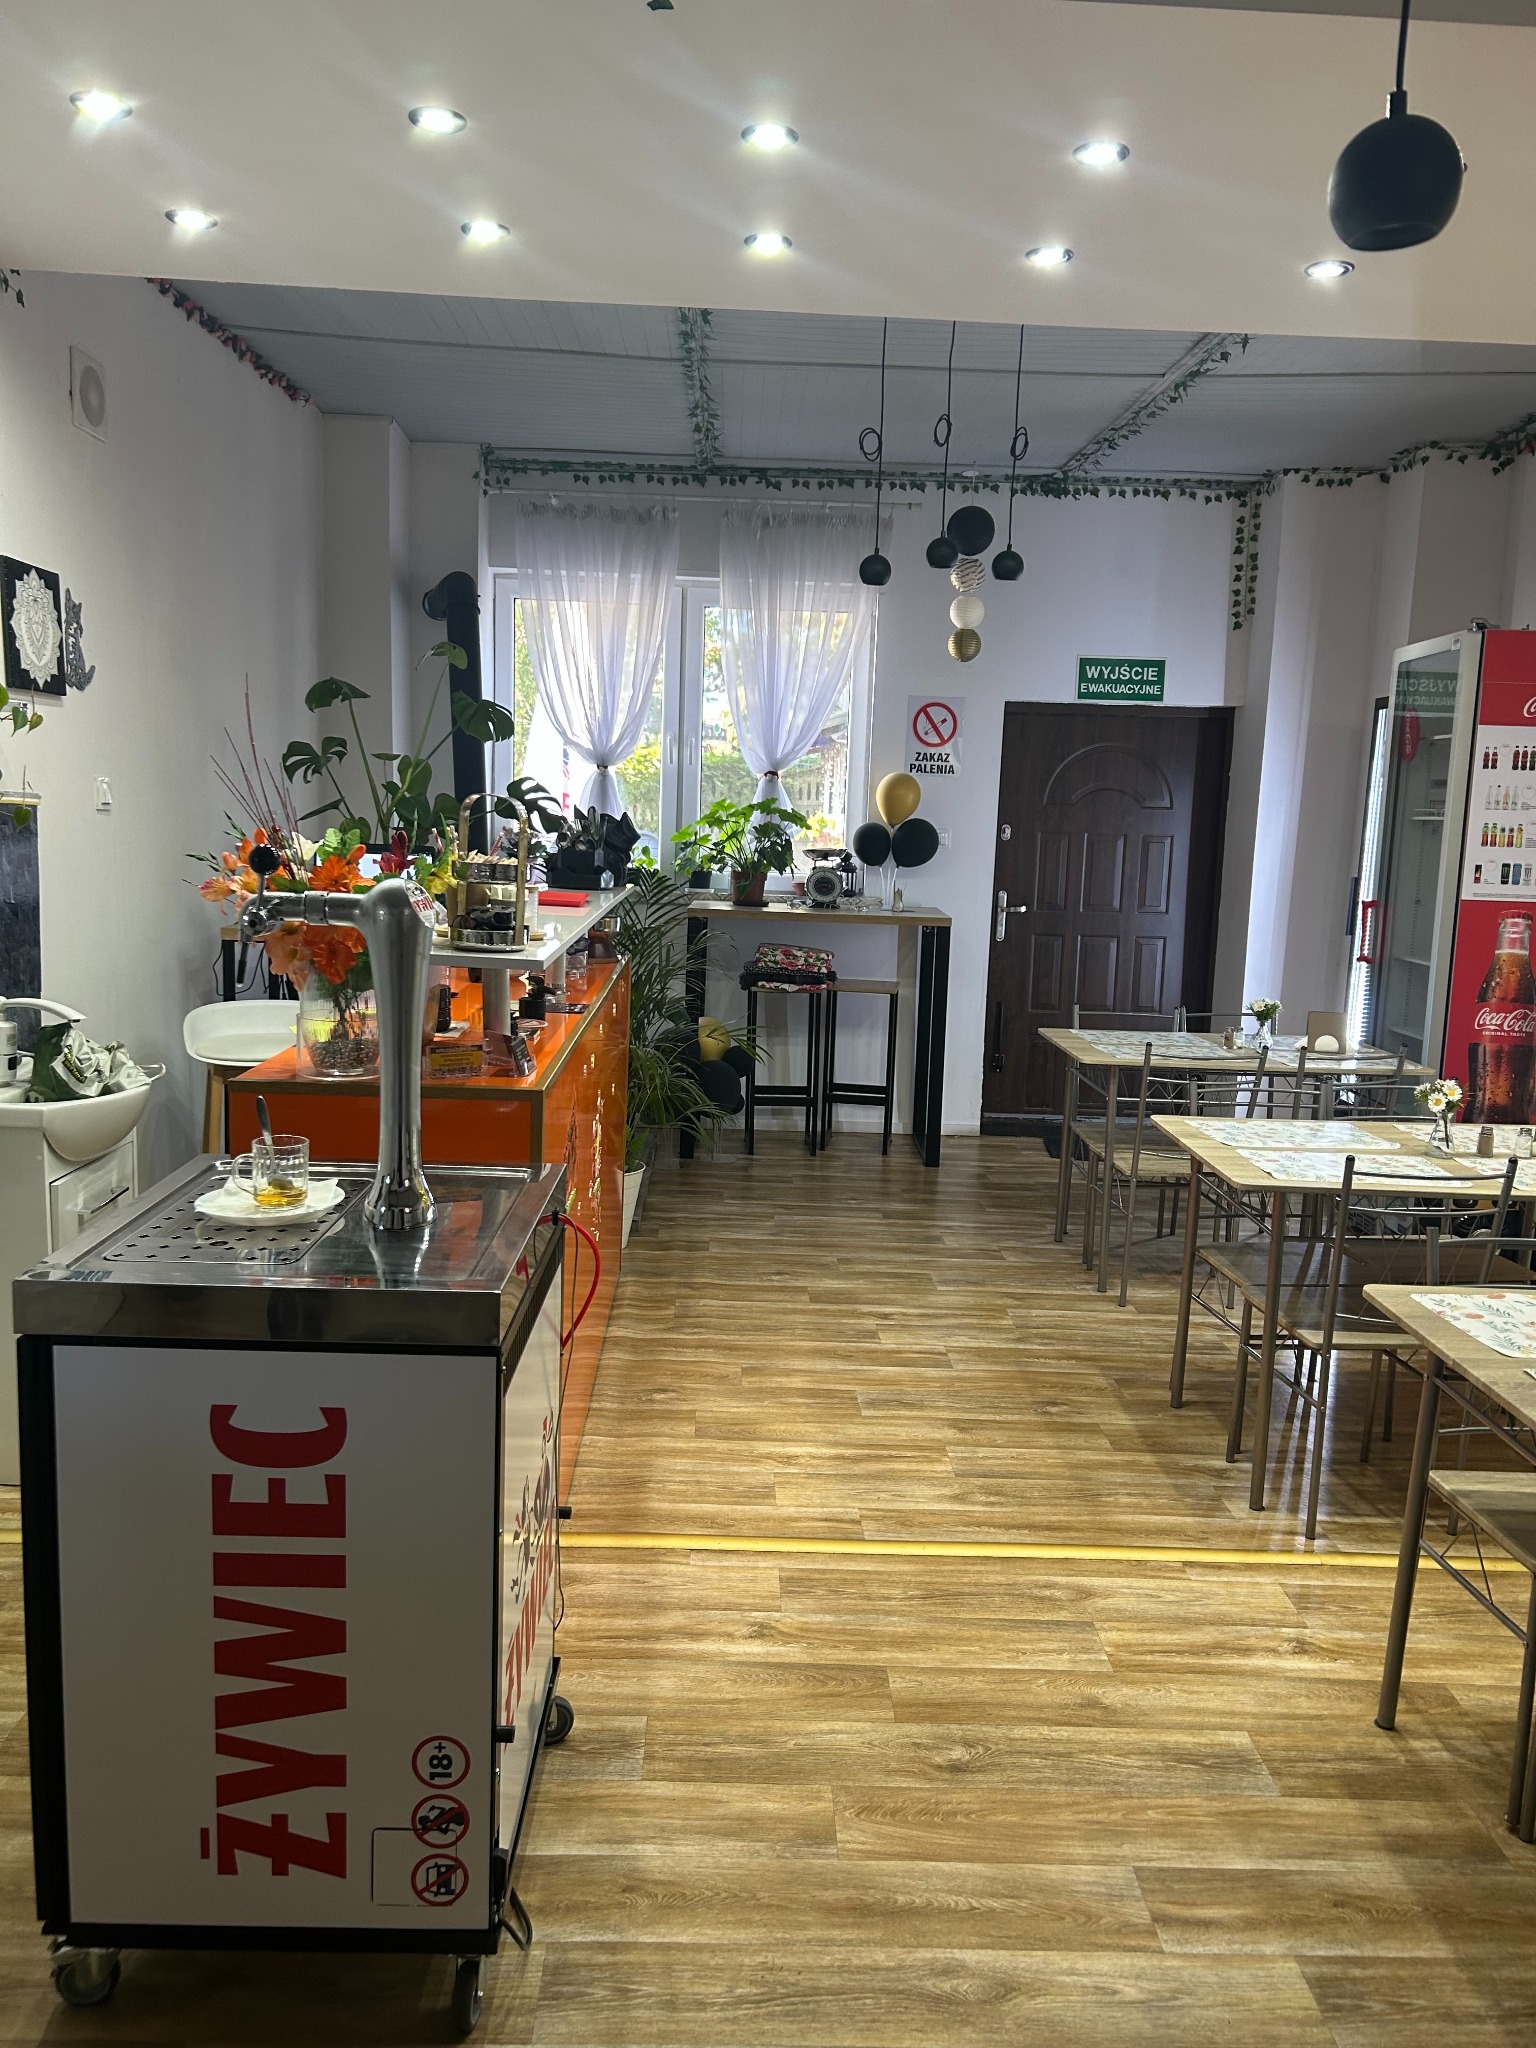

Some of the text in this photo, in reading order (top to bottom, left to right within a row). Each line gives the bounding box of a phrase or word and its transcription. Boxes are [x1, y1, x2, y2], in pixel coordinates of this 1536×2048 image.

[1086, 663, 1159, 681] WYJŚCIE
[1080, 683, 1162, 695] EWAKUACYJNE
[914, 751, 951, 763] ZAKAZ
[909, 763, 955, 775] PALENIA
[1474, 1007, 1536, 1033] Coca-Cola
[200, 1404, 348, 1880] ŻYWIEC
[428, 1741, 453, 1781] 18+
